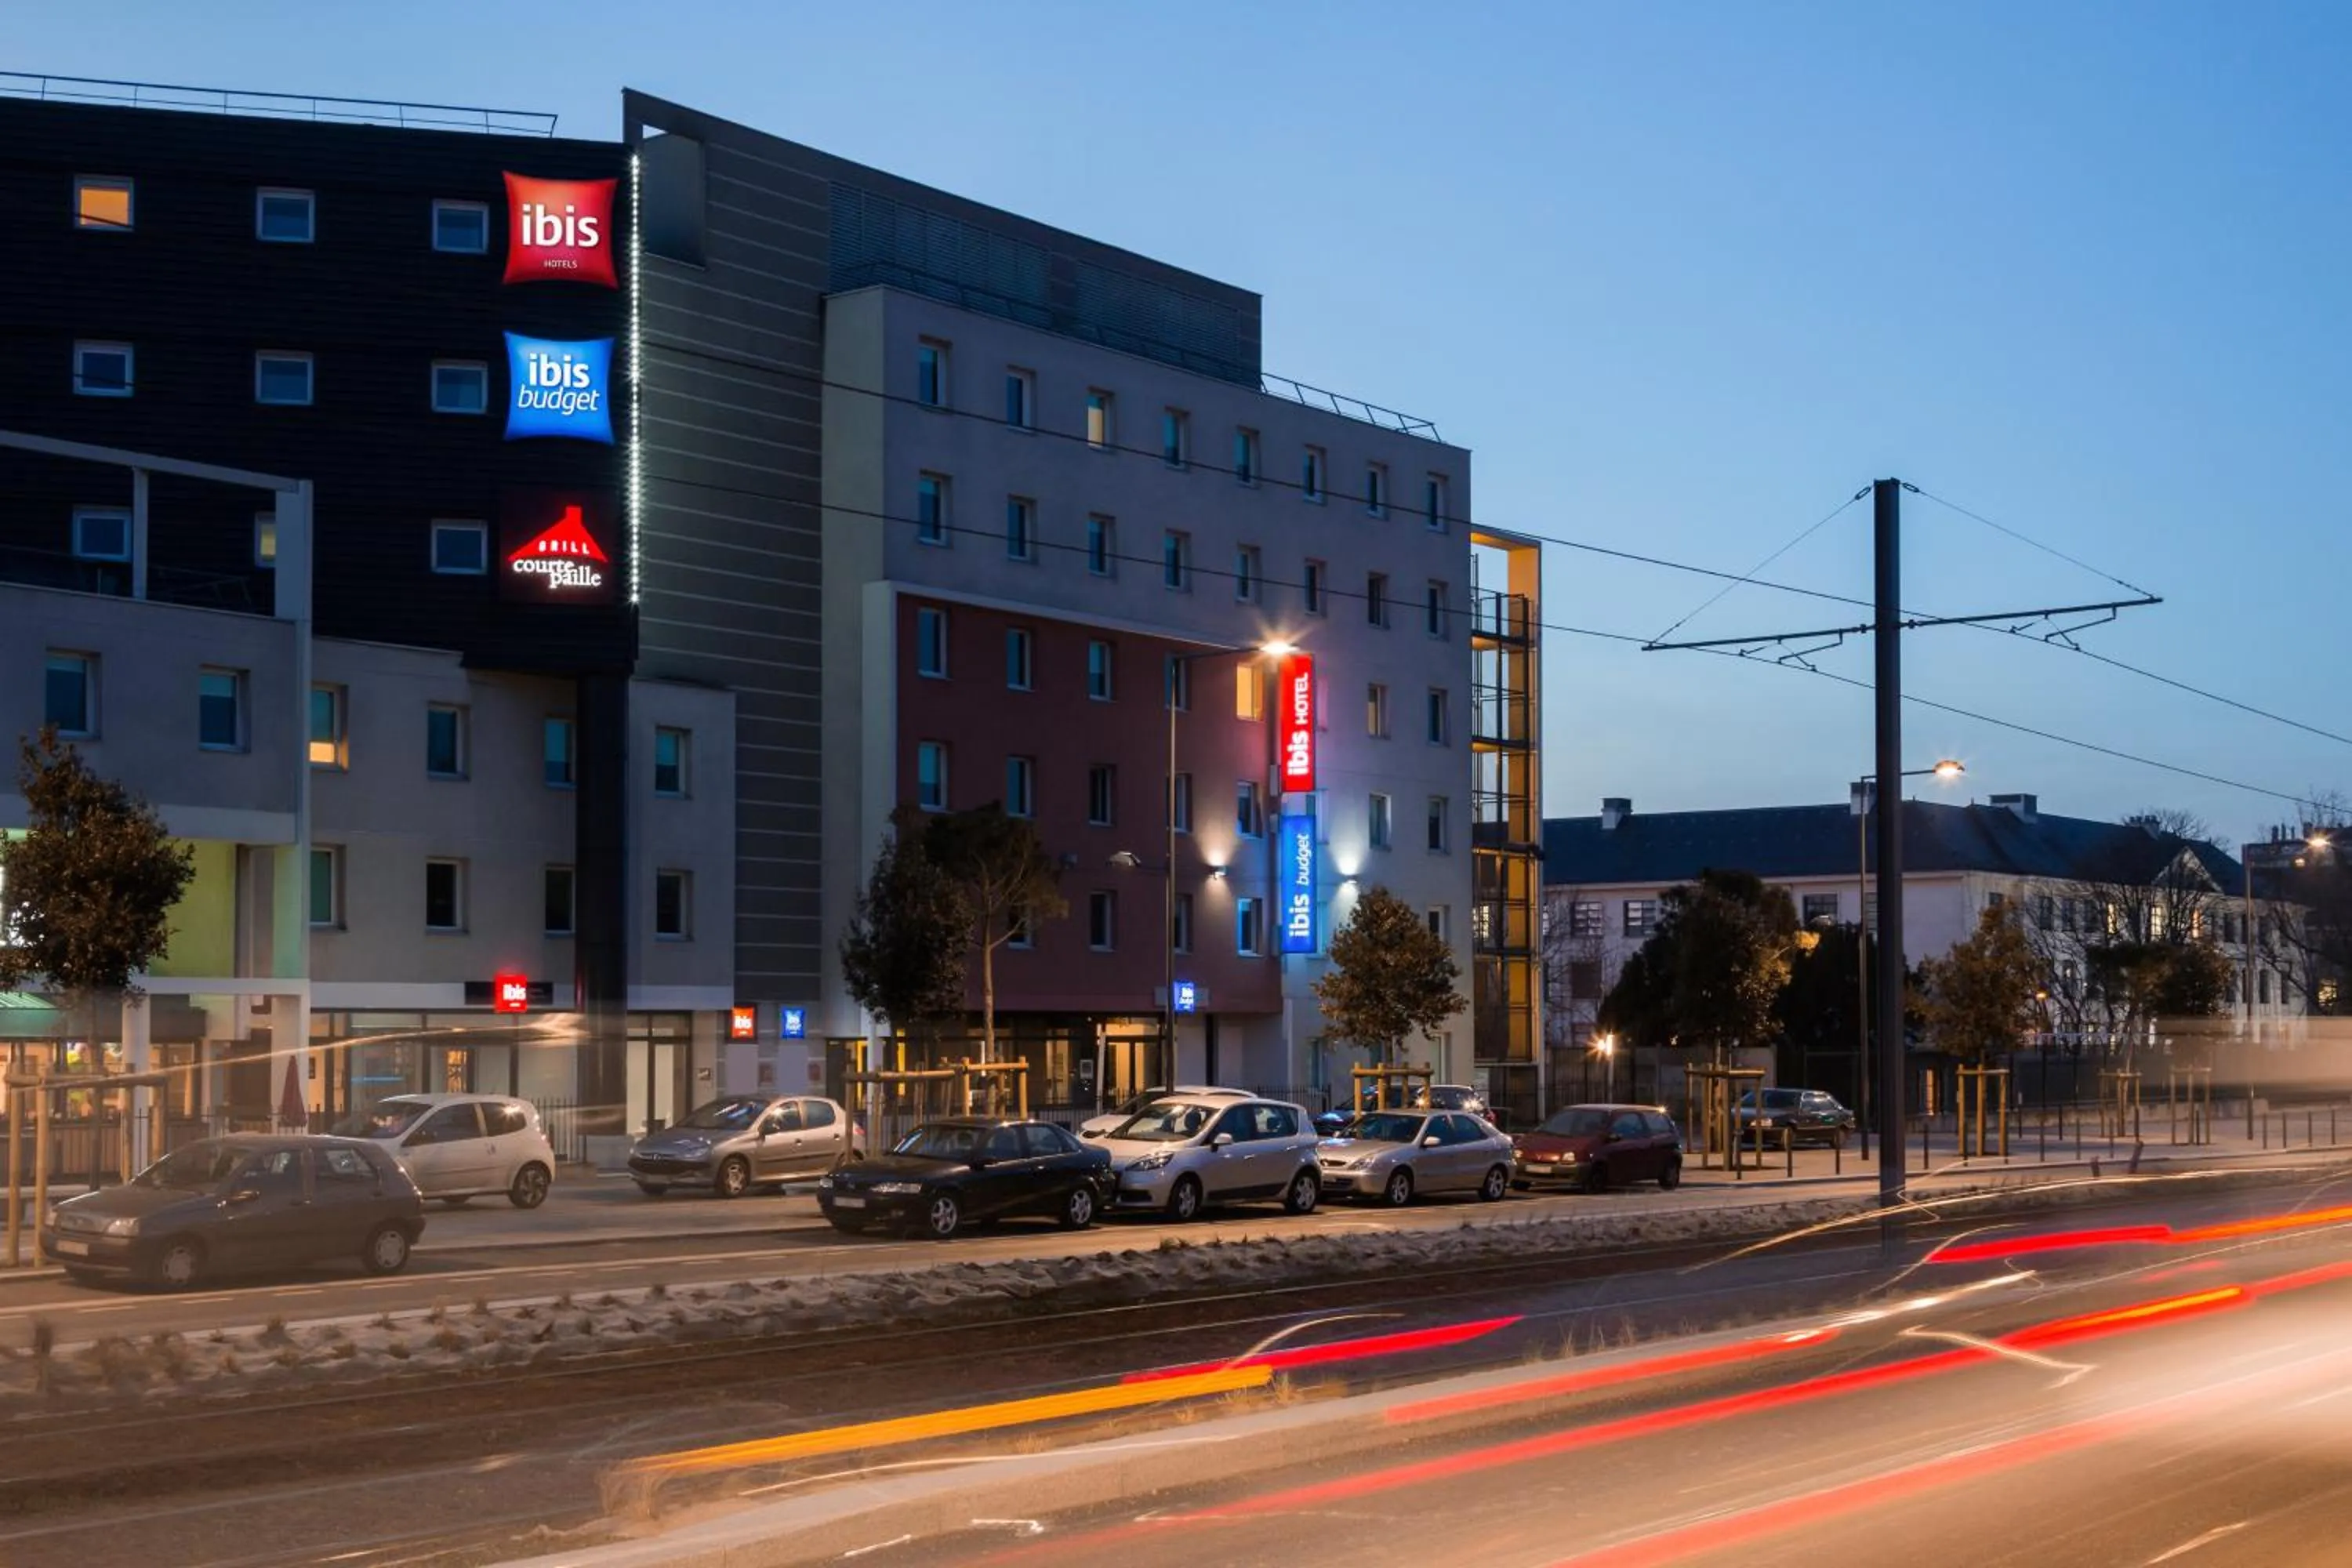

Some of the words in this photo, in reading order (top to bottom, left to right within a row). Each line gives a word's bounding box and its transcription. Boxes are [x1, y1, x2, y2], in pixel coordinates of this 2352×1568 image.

[522, 204, 599, 247] ibis
[544, 260, 578, 269] HOTELS
[529, 353, 590, 388] ibis
[518, 384, 600, 416] budget
[514, 559, 575, 573] courte
[549, 566, 601, 589] paille
[1295, 673, 1308, 724] HOTEL
[1287, 730, 1309, 775] ibis
[1296, 833, 1312, 886] budget
[1289, 893, 1309, 937] ibis
